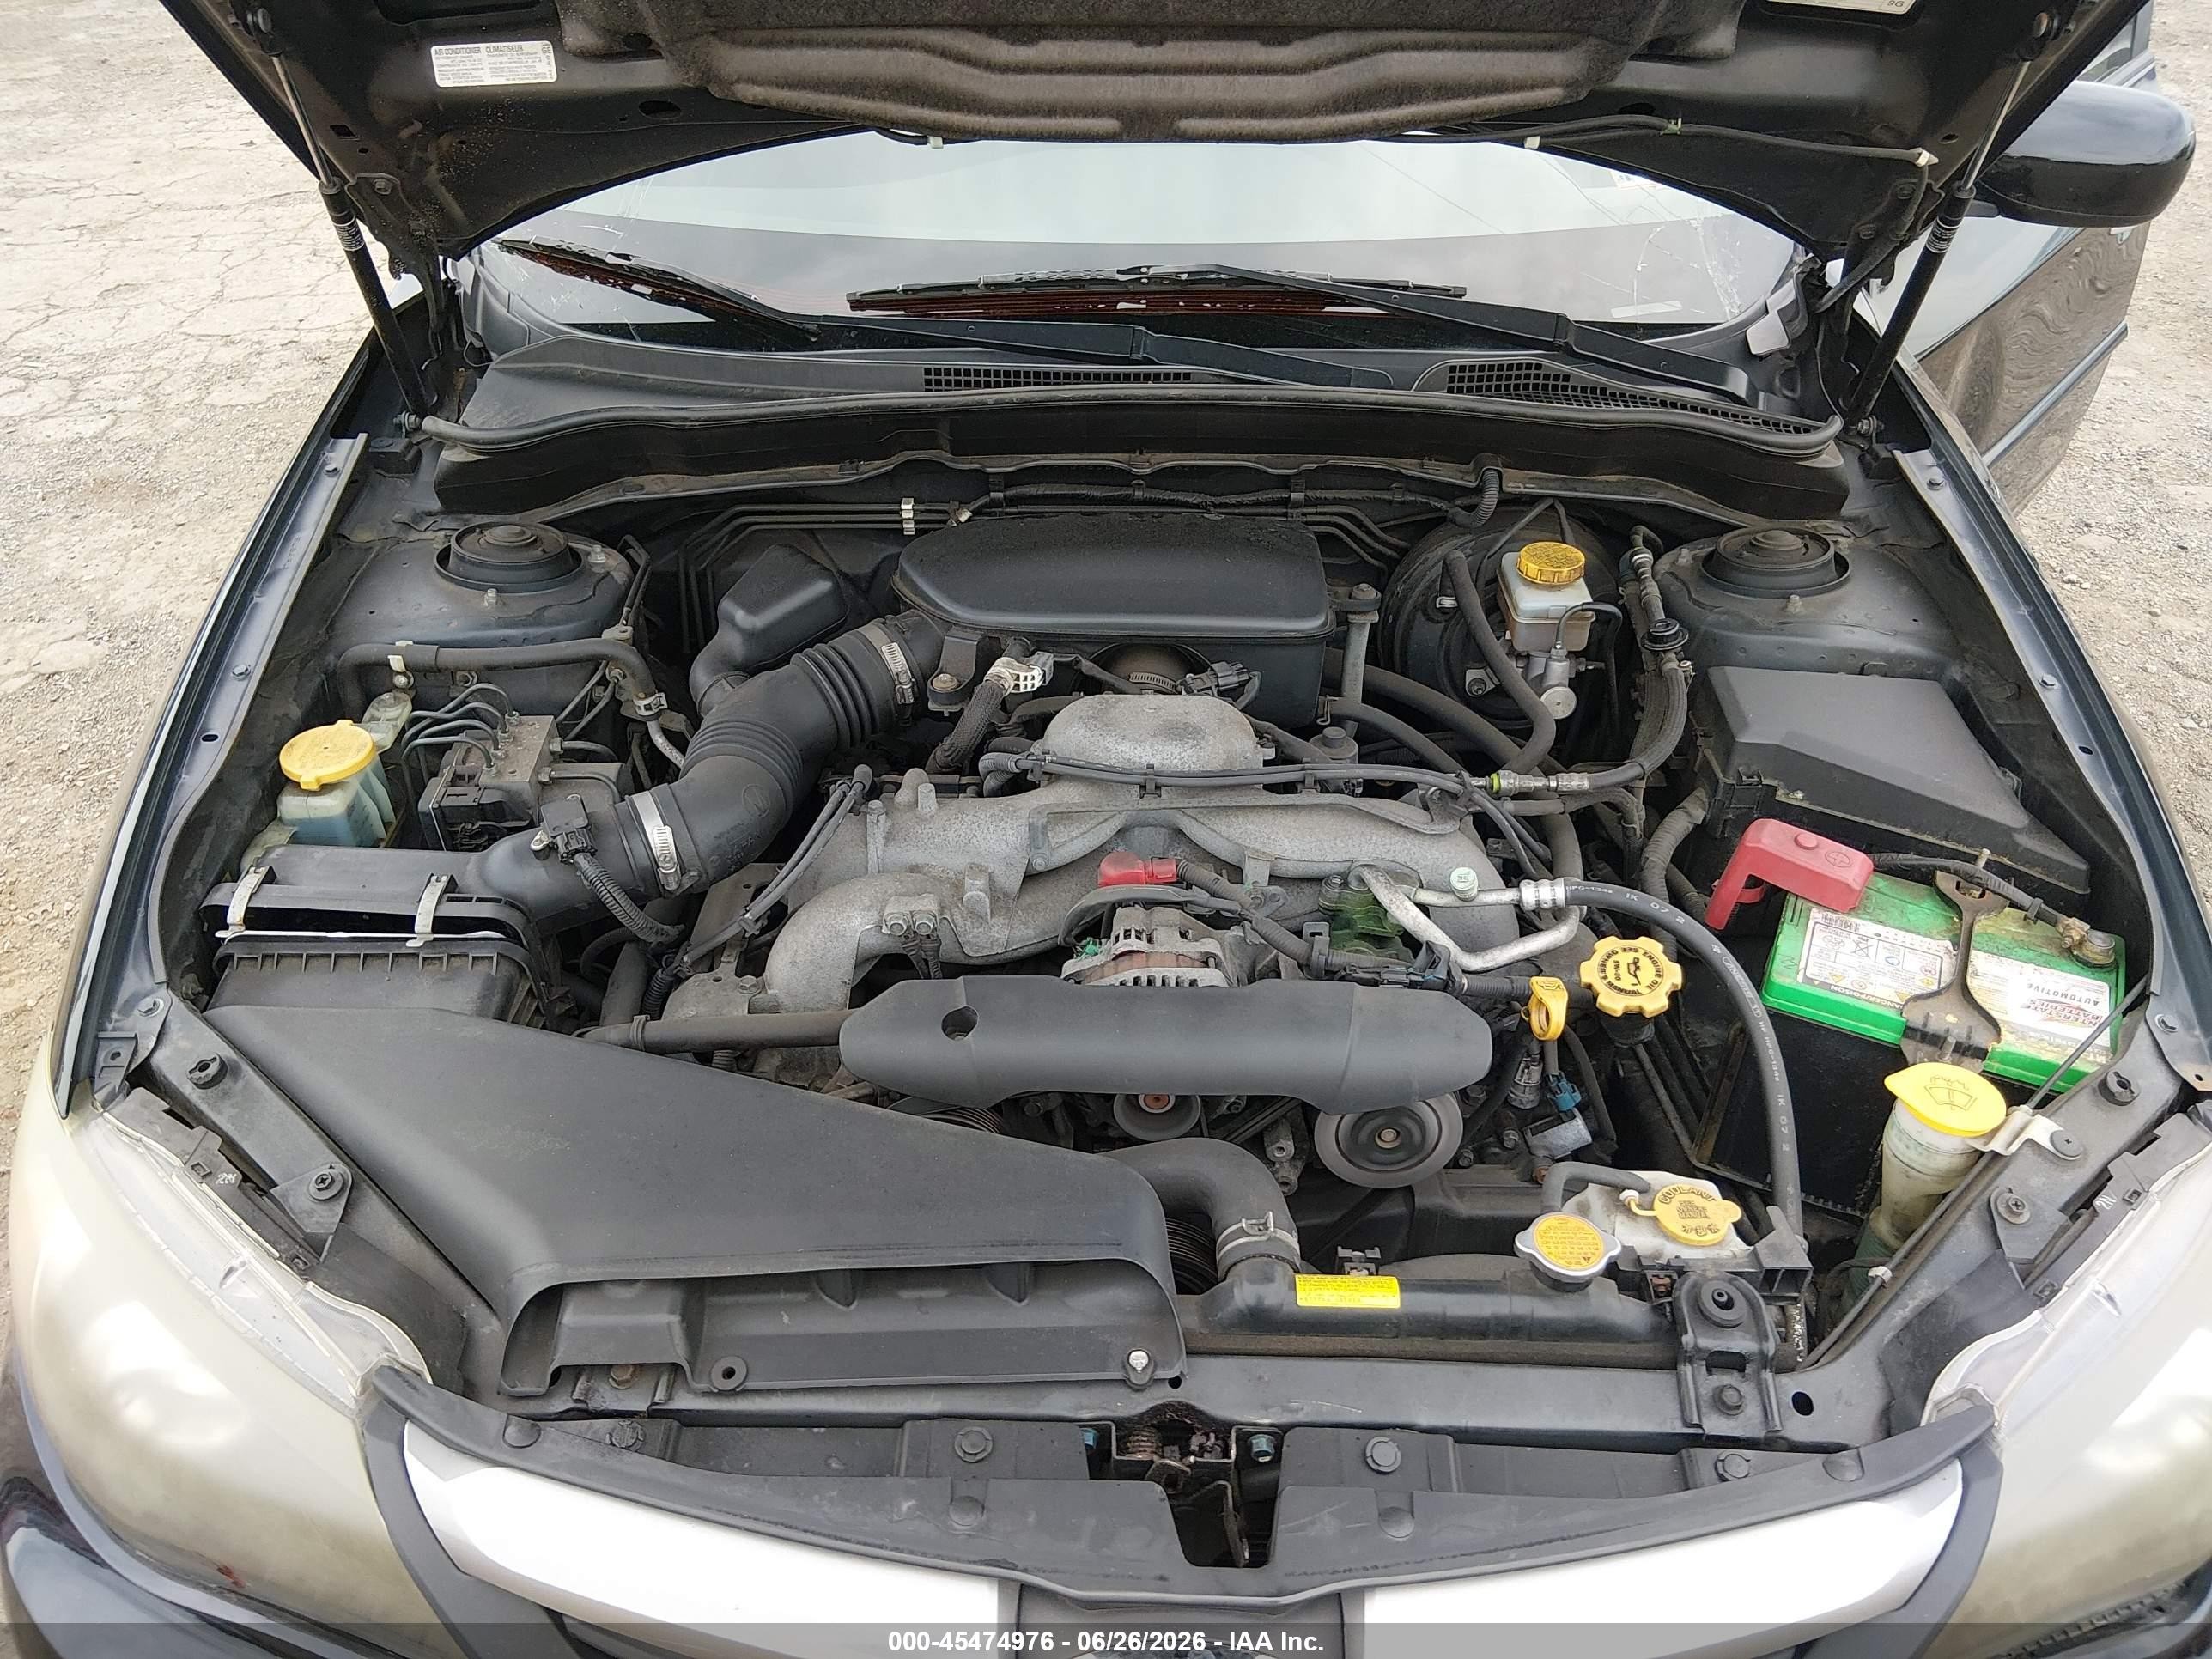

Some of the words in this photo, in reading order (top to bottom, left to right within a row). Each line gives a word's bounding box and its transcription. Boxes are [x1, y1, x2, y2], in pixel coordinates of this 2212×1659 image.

[445, 46, 481, 55] CONDITIONER
[485, 45, 523, 54] CLIMATISEUR
[1650, 902, 1669, 913] 07
[1642, 951, 1662, 978] ENGINE
[1606, 981, 1642, 994] MANUAL
[1645, 979, 1659, 989] OIL
[1830, 985, 1904, 1010] ANGER/POISON
[2027, 983, 2100, 1006] AUTOMOTIVE
[2023, 1005, 2098, 1026] NTERSTATE
[2030, 999, 2100, 1020] BATTERIES
[1779, 1115, 1789, 1133] 07
[1658, 1187, 1717, 1204] COOLANT
